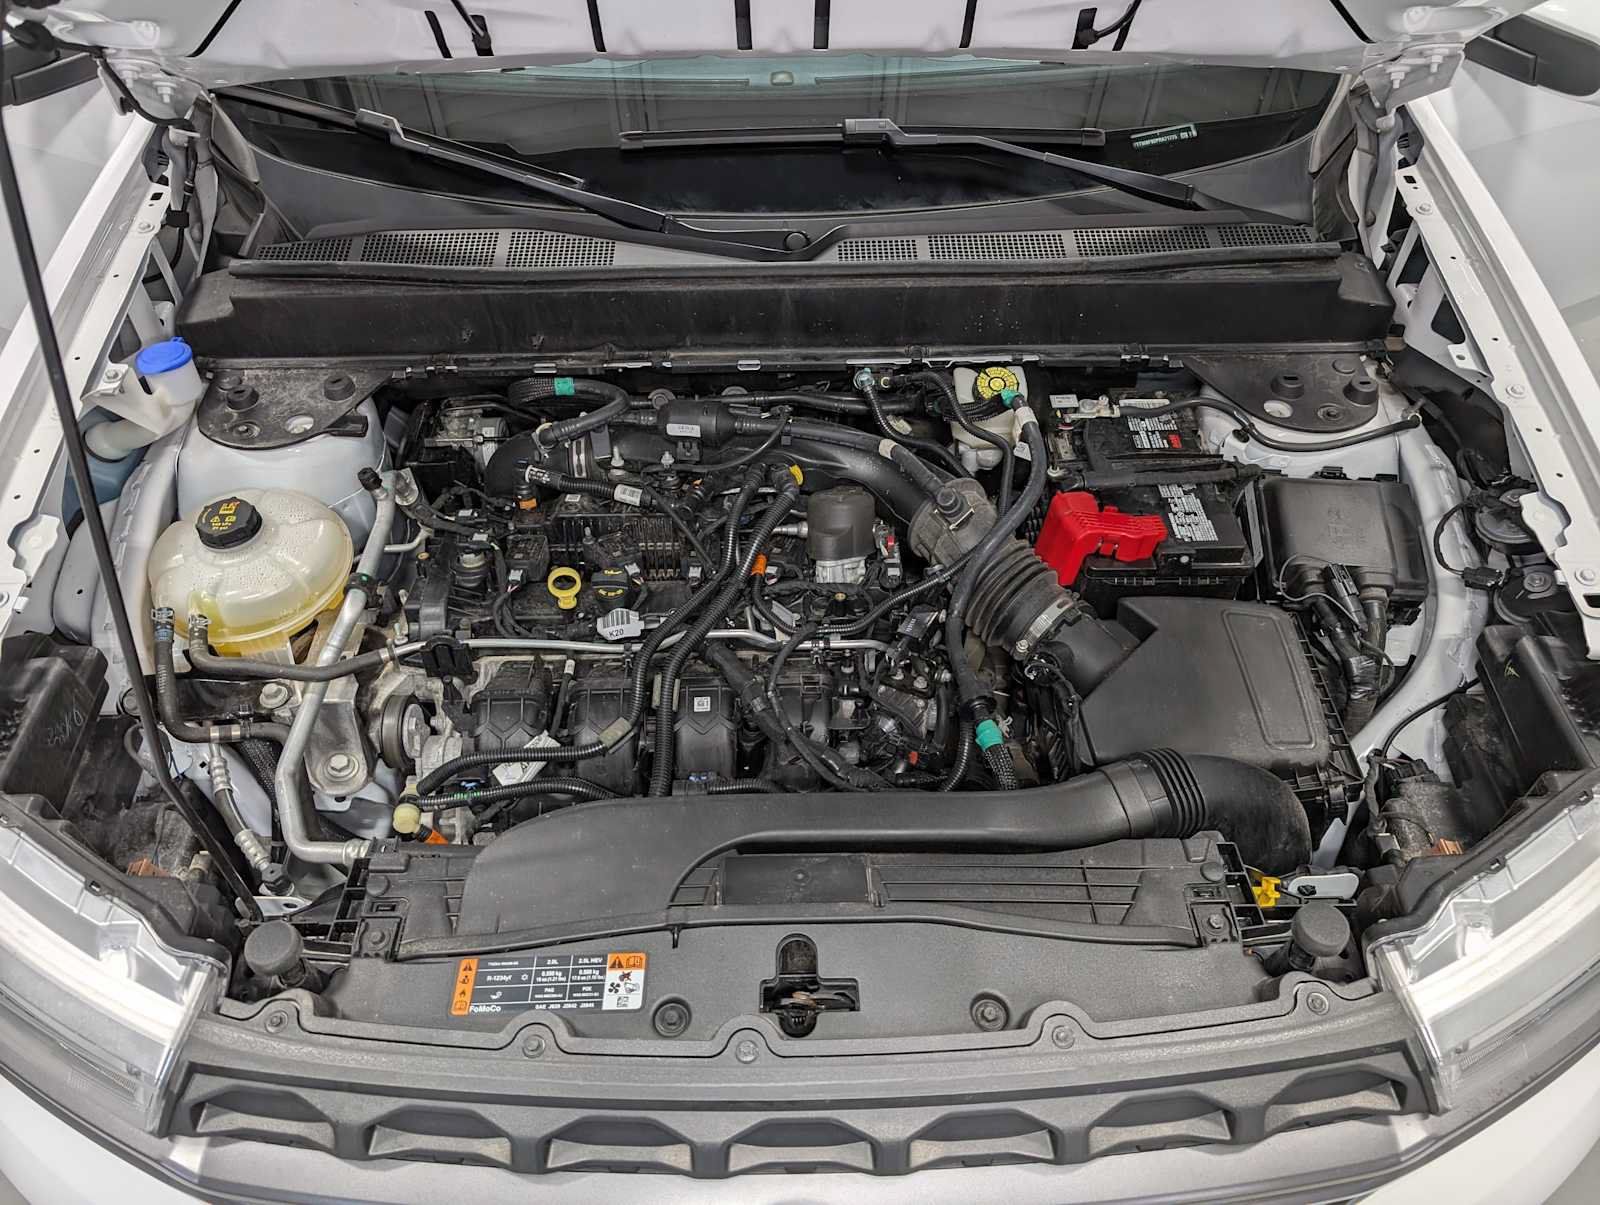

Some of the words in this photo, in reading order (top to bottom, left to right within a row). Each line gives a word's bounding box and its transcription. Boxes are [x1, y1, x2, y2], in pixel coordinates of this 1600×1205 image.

[608, 629, 624, 638] K20
[486, 974, 512, 982] R-1234yf
[470, 1004, 502, 1013] FoMoCo
